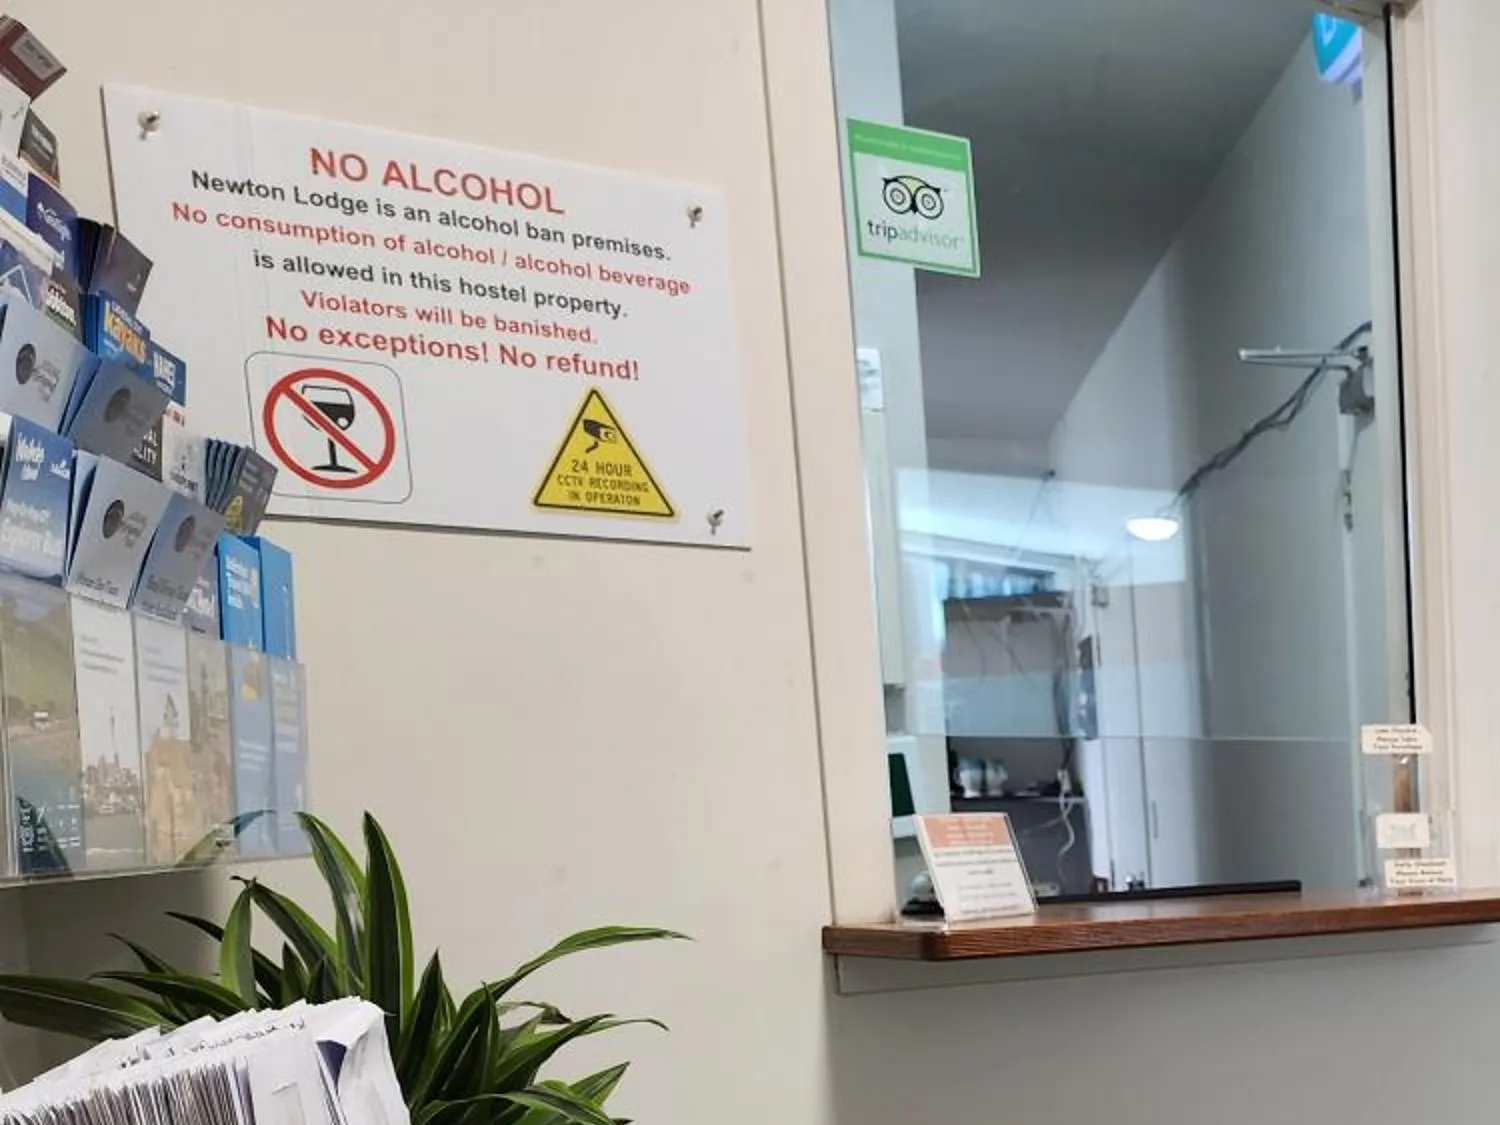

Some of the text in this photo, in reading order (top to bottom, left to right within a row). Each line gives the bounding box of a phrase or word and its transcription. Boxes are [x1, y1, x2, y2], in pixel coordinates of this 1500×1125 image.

[309, 147, 566, 215] NO ALCOHOL
[171, 200, 691, 297] No consumption of alcohol / alcohol beverage
[191, 169, 672, 262] Newton Lodge is an alcohol ban premises.
[253, 249, 629, 321] is allowed in this hostel property.
[300, 289, 598, 345] Violators will be banished.
[265, 315, 641, 382] No exceptions! No refund!
[557, 474, 650, 494] CCTV RECORDING
[571, 458, 633, 479] 24 HOUR
